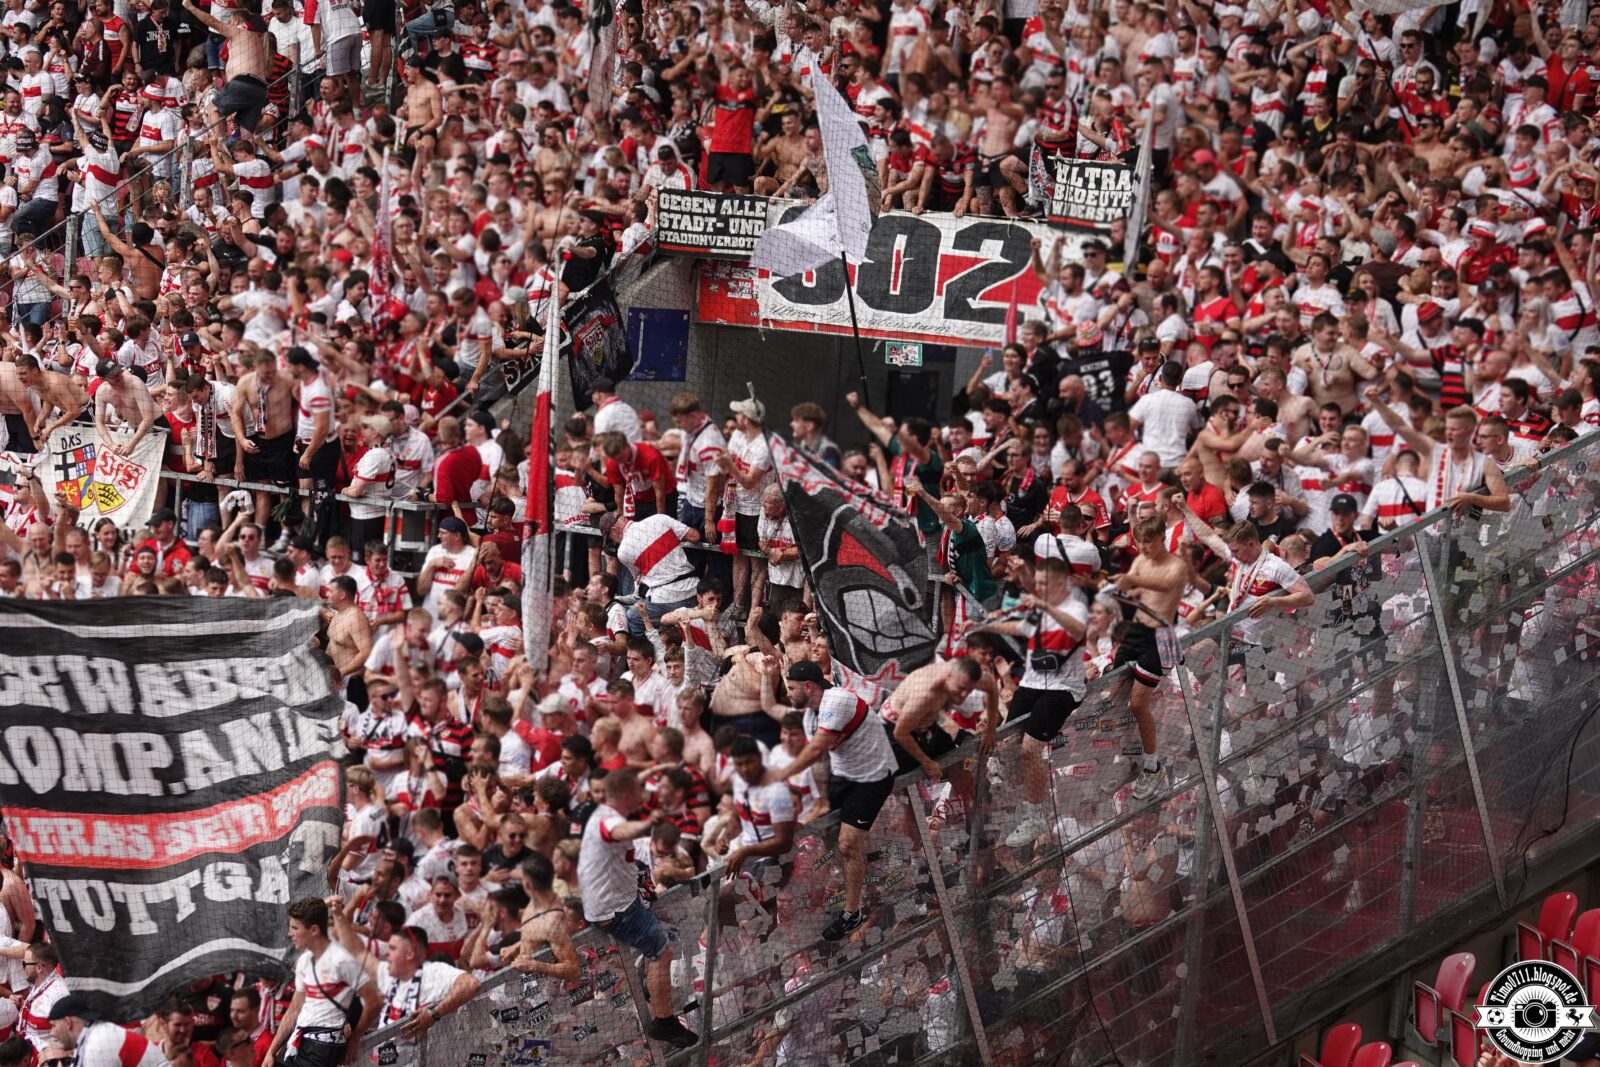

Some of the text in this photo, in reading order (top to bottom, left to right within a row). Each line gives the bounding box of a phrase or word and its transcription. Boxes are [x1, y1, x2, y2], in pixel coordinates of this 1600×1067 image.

[1056, 161, 1131, 191] ULTRA
[659, 193, 767, 218] GEGEN ALLE
[1053, 183, 1133, 208] BEDEUTE
[1052, 200, 1124, 222] WIDERSTA
[659, 213, 765, 237] STADT- UND
[11, 815, 156, 861] LTRAS
[162, 804, 268, 855] SEIT
[30, 820, 340, 936] TUTTGAT
